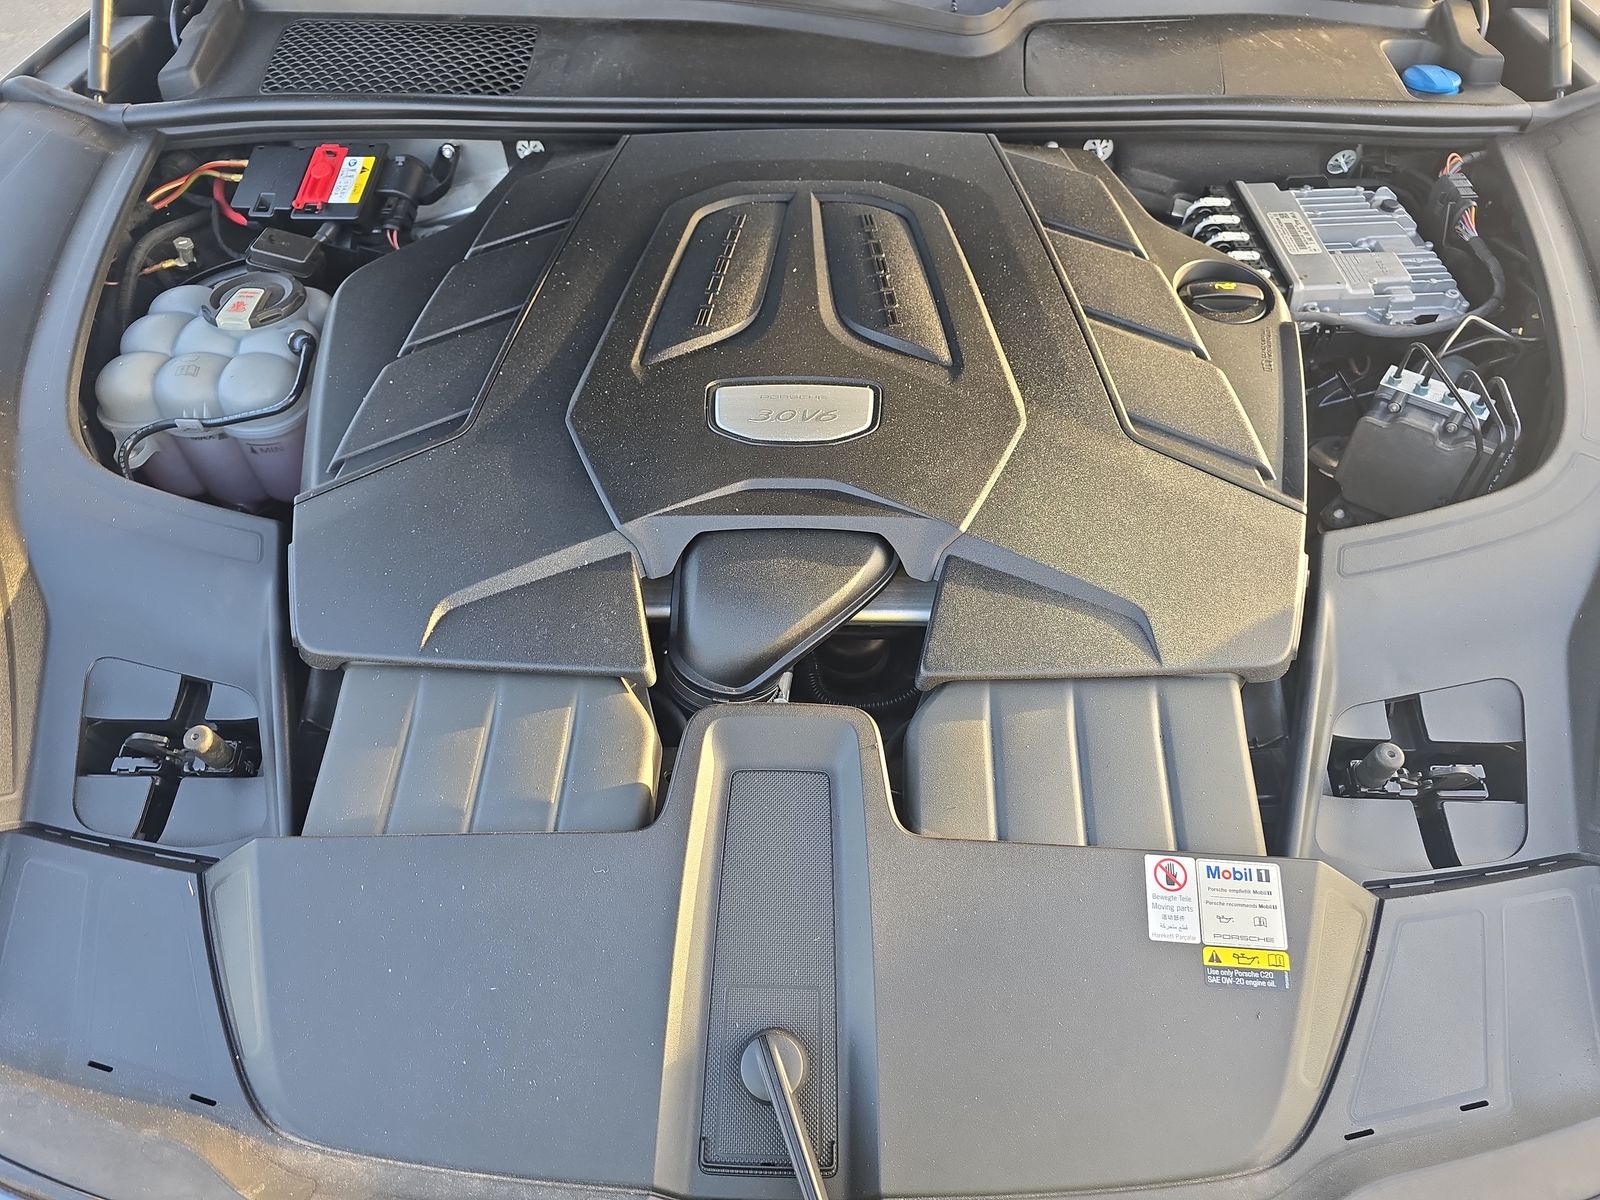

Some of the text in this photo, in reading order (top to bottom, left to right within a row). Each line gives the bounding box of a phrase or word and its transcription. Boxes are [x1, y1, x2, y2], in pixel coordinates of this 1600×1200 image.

[1206, 865, 1271, 883] Mobil 1
[1151, 893, 1178, 902] Bewegte
[1205, 899, 1226, 907] Porsche
[1151, 902, 1194, 913] Moving parts
[1213, 933, 1275, 944] PORSCHE
[1206, 967, 1274, 979] Use only Porsche C20
[1207, 976, 1221, 984] SAE
[1245, 979, 1267, 988] engine
